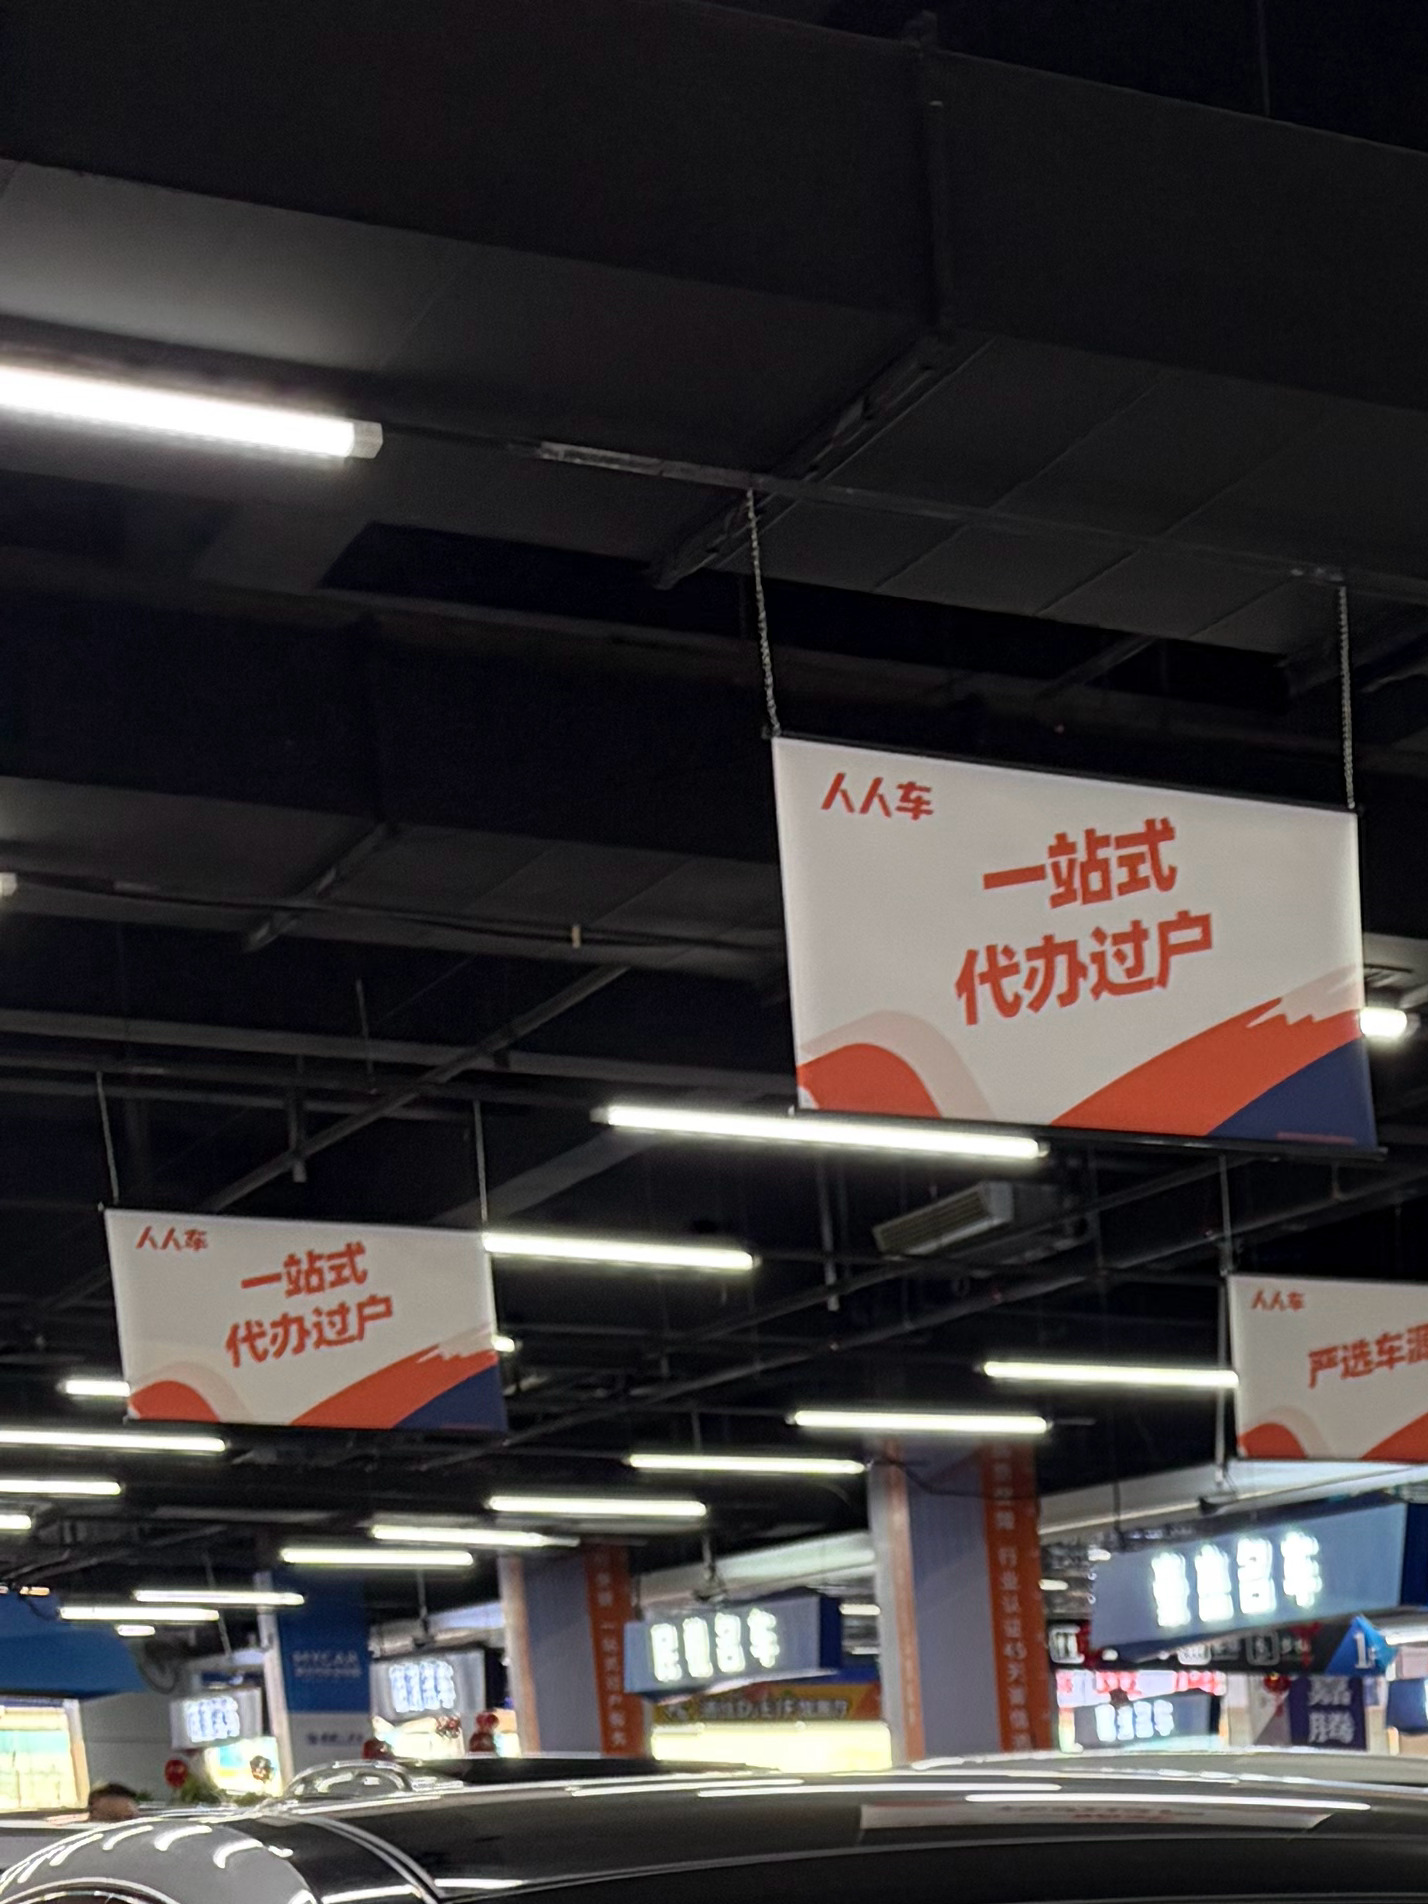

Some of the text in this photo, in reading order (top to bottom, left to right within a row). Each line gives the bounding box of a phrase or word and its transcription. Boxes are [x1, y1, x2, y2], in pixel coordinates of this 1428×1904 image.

[821, 772, 934, 820] 人人车
[983, 817, 1177, 909] 一站式
[955, 910, 1212, 1025] 代办过户
[136, 1225, 208, 1253] 人人车
[241, 1242, 367, 1297] 一站式
[1252, 1289, 1305, 1311] 人人车
[225, 1294, 393, 1368] 代办过户
